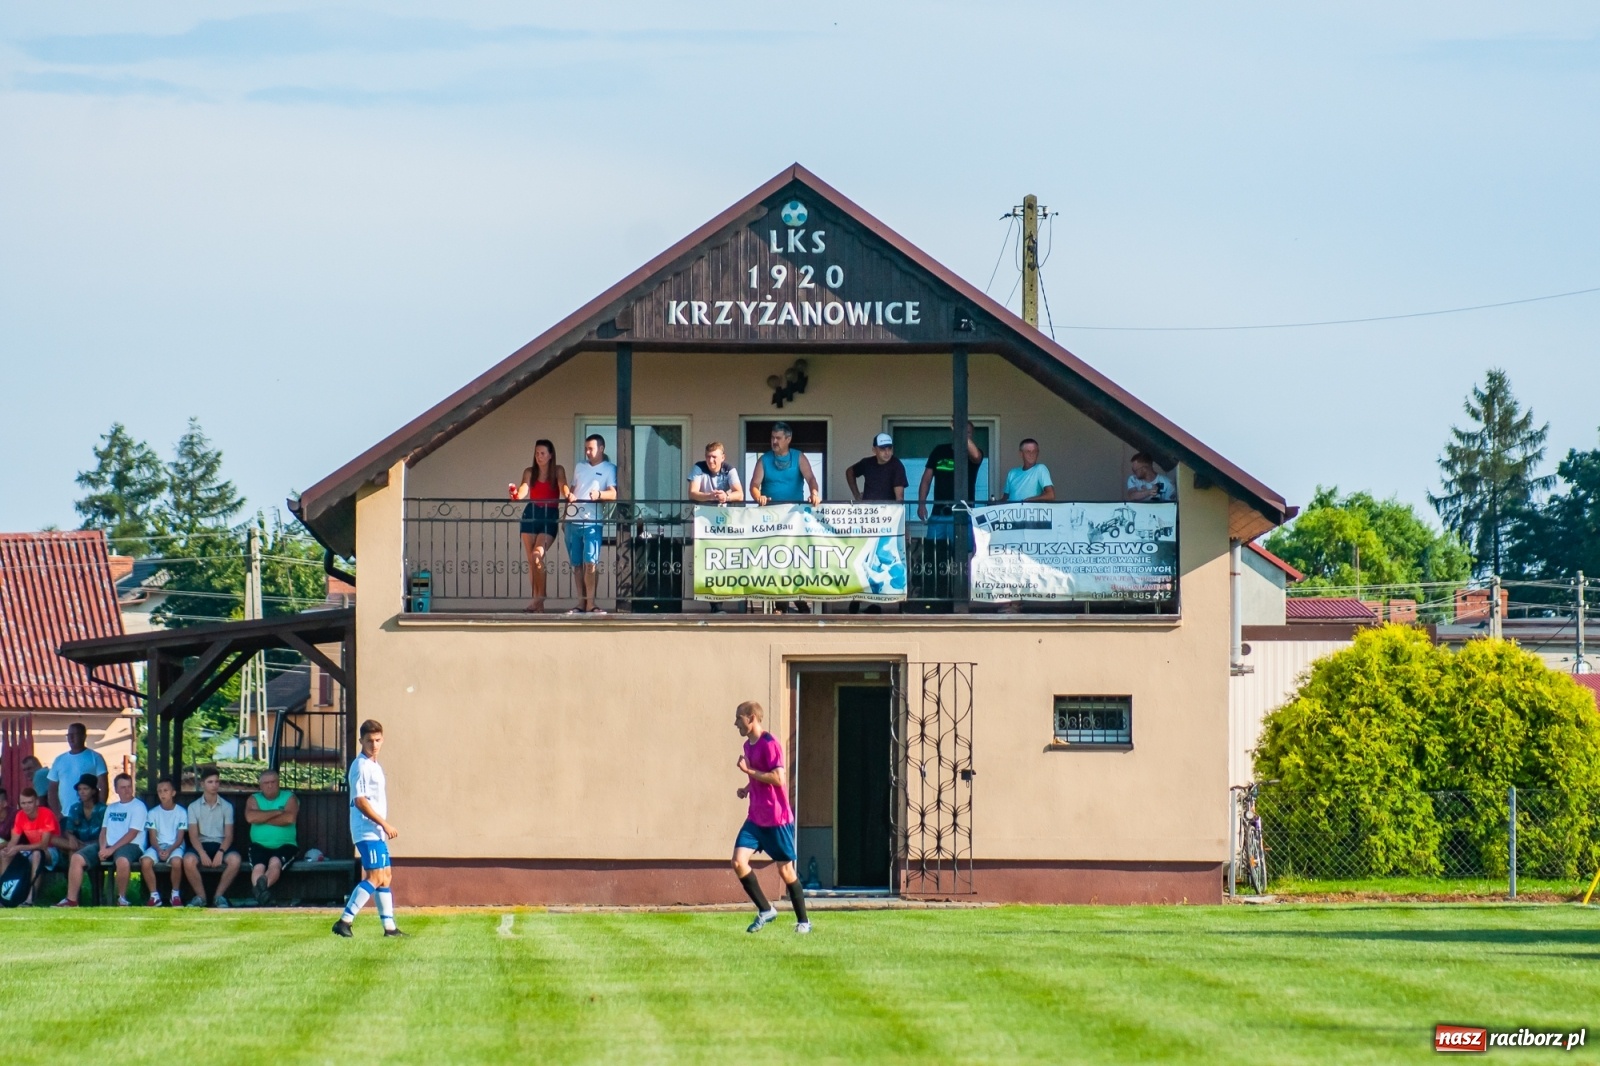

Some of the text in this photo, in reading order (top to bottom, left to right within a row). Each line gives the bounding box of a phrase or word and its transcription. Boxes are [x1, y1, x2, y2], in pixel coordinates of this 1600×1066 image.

[769, 229, 826, 253] LKS
[748, 264, 844, 289] 1920
[667, 294, 921, 326] KRZYŻANOWICE
[864, 507, 879, 515] 236
[999, 508, 1052, 522] KUHN
[832, 517, 846, 525] 151
[870, 516, 881, 524] 81
[882, 516, 892, 524] 99
[704, 525, 745, 534] L&M Bau
[752, 523, 794, 533] K&M Bau
[989, 542, 1159, 556] BRUKARSTWO
[704, 545, 854, 571] REMONTY
[1112, 565, 1172, 574] HURTOWYCH
[705, 572, 850, 588] BUDOWA DOMÓW
